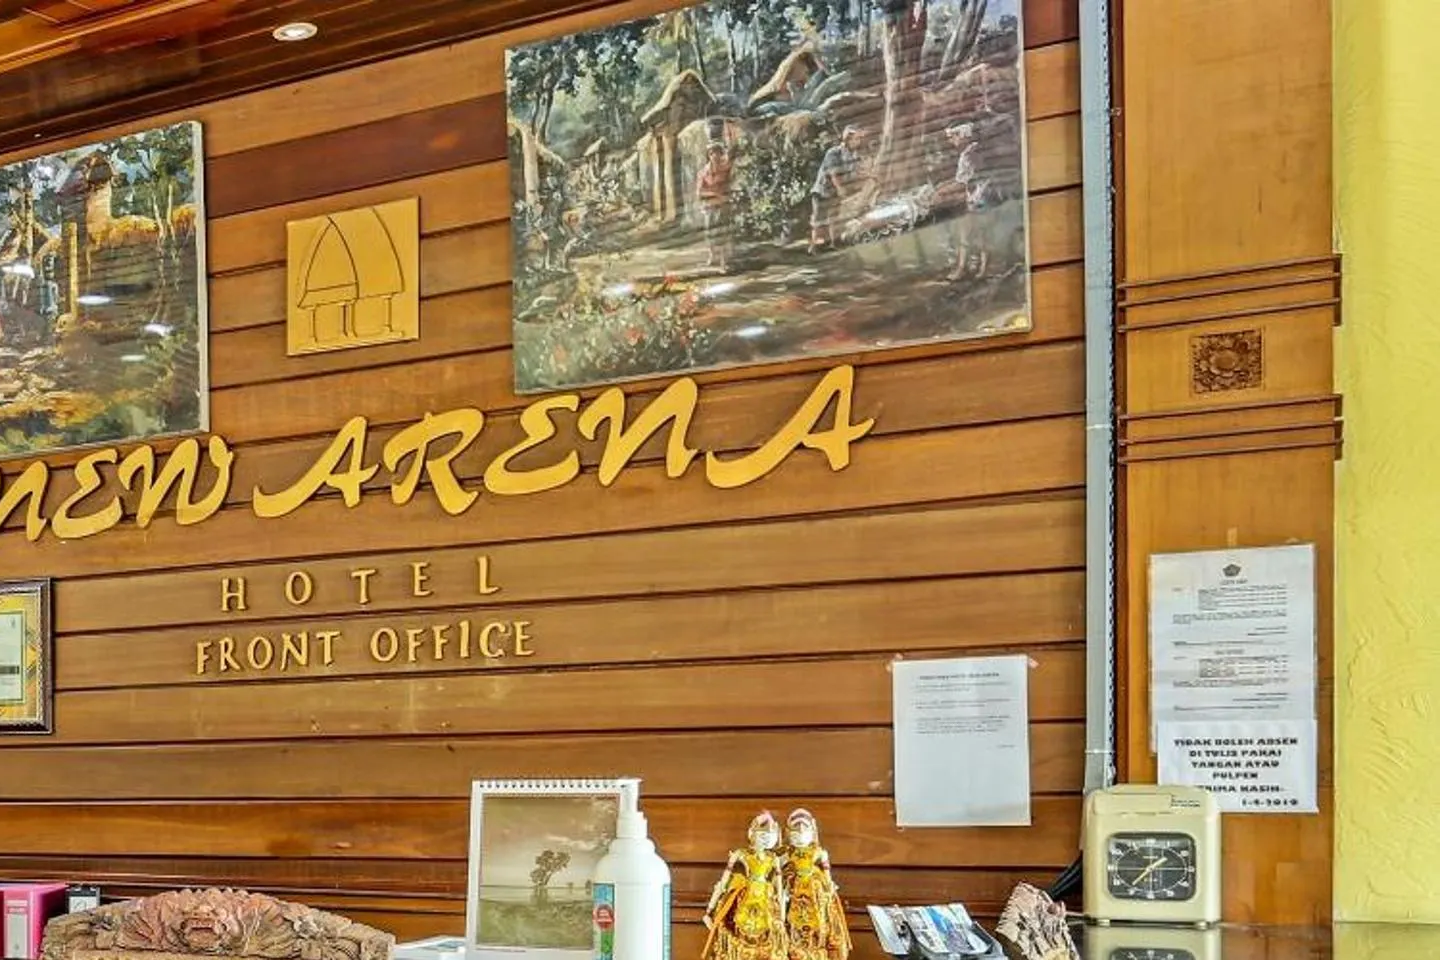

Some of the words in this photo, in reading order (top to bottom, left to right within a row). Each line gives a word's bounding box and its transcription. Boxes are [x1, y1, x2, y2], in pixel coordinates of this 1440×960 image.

[253, 364, 875, 517] ARENA
[220, 556, 501, 612] HOTEL
[195, 630, 344, 676] FRONT
[370, 620, 536, 664] OFFICE
[1174, 738, 1211, 747] TIDAK
[1214, 738, 1253, 746] BOLEH
[1257, 737, 1298, 746] ABSEN
[1189, 750, 1201, 758] DI
[1204, 749, 1237, 757] TULIS
[1241, 749, 1282, 757] PAKAI
[1191, 760, 1241, 768] TANGAN
[1245, 760, 1280, 768] ATAU
[1212, 771, 1258, 779] PULPEN
[1195, 785, 1236, 793] RIMA
